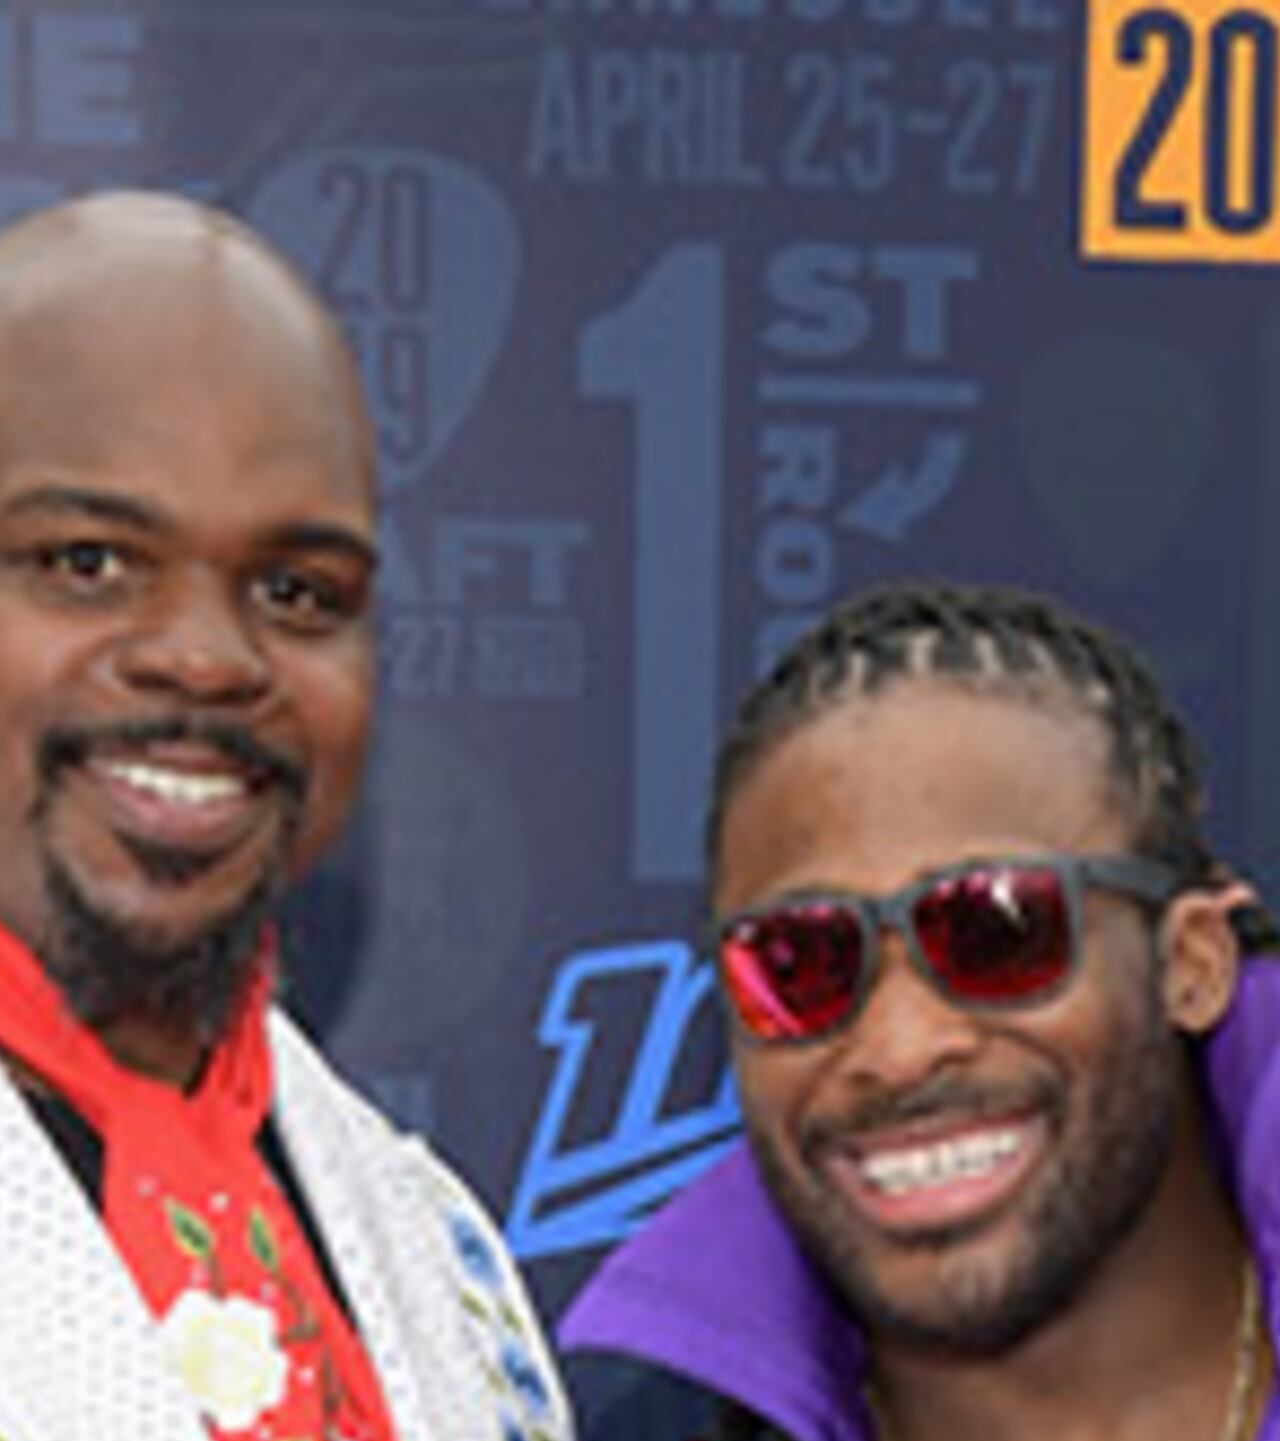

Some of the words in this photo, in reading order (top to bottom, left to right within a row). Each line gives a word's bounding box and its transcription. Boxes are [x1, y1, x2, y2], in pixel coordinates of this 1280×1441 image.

[523, 45, 765, 186] APRIL
[782, 50, 1057, 196] 25-27
[758, 240, 982, 360] ST
